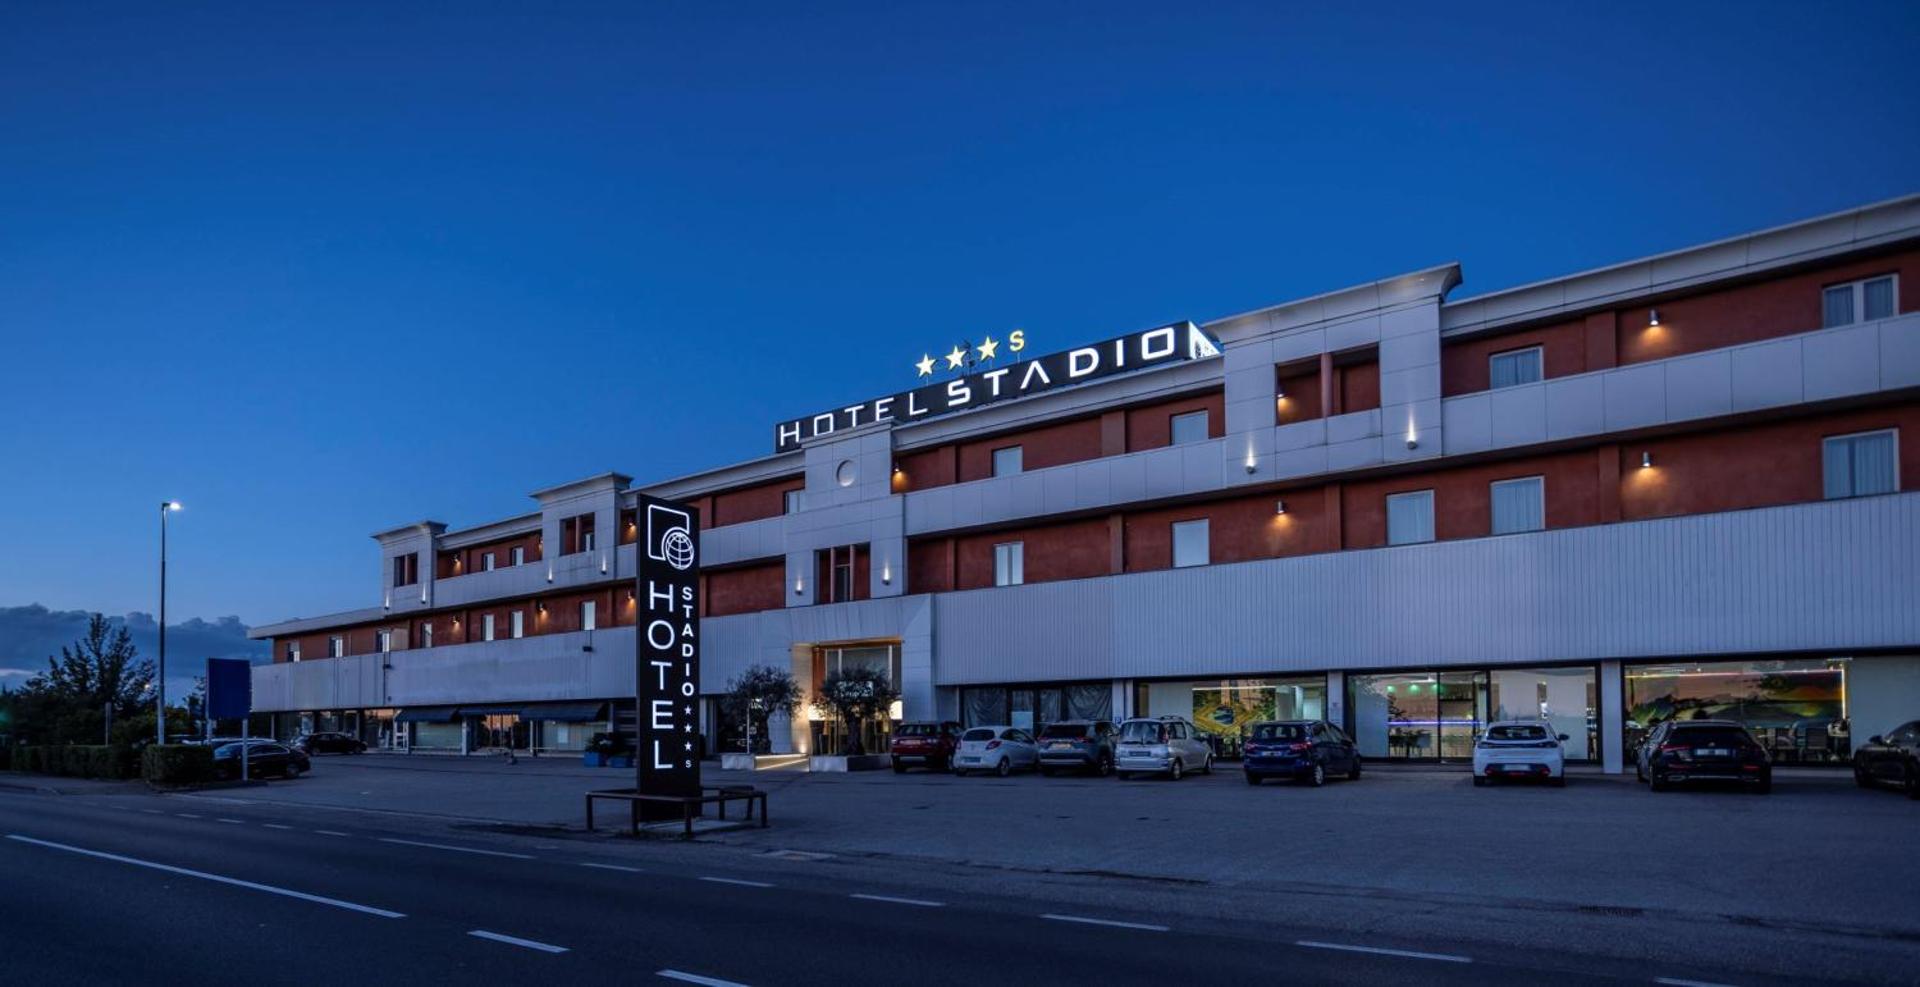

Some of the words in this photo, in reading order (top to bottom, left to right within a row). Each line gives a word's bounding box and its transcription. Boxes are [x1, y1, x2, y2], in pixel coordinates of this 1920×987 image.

[779, 393, 928, 447] HOTEL
[947, 327, 1175, 406] STADIO
[1009, 330, 1025, 352] S
[648, 580, 675, 770] HOTEL
[681, 586, 695, 697] STADIO
